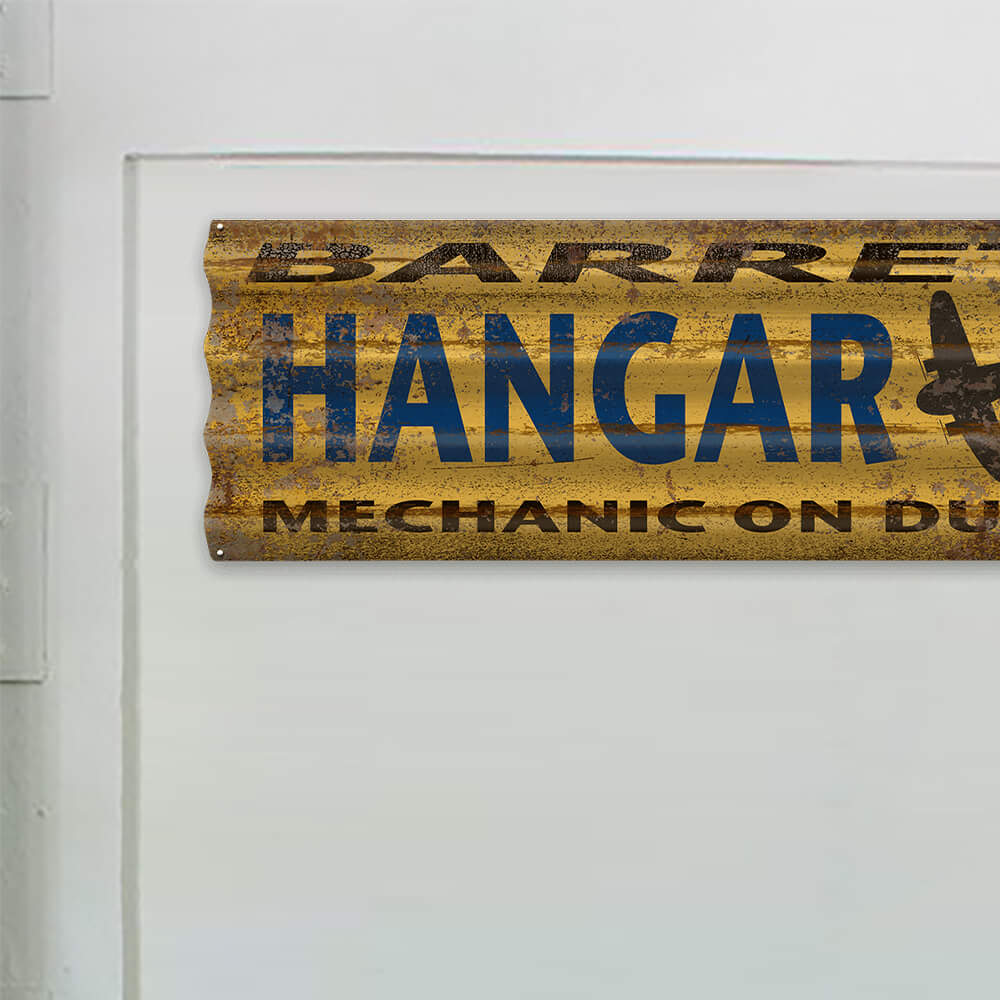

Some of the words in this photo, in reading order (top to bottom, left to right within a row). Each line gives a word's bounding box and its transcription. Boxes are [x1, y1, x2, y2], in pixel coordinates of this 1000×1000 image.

[262, 311, 898, 465] HANGAR
[262, 500, 706, 533] MECHANIC
[733, 500, 852, 533] ON
